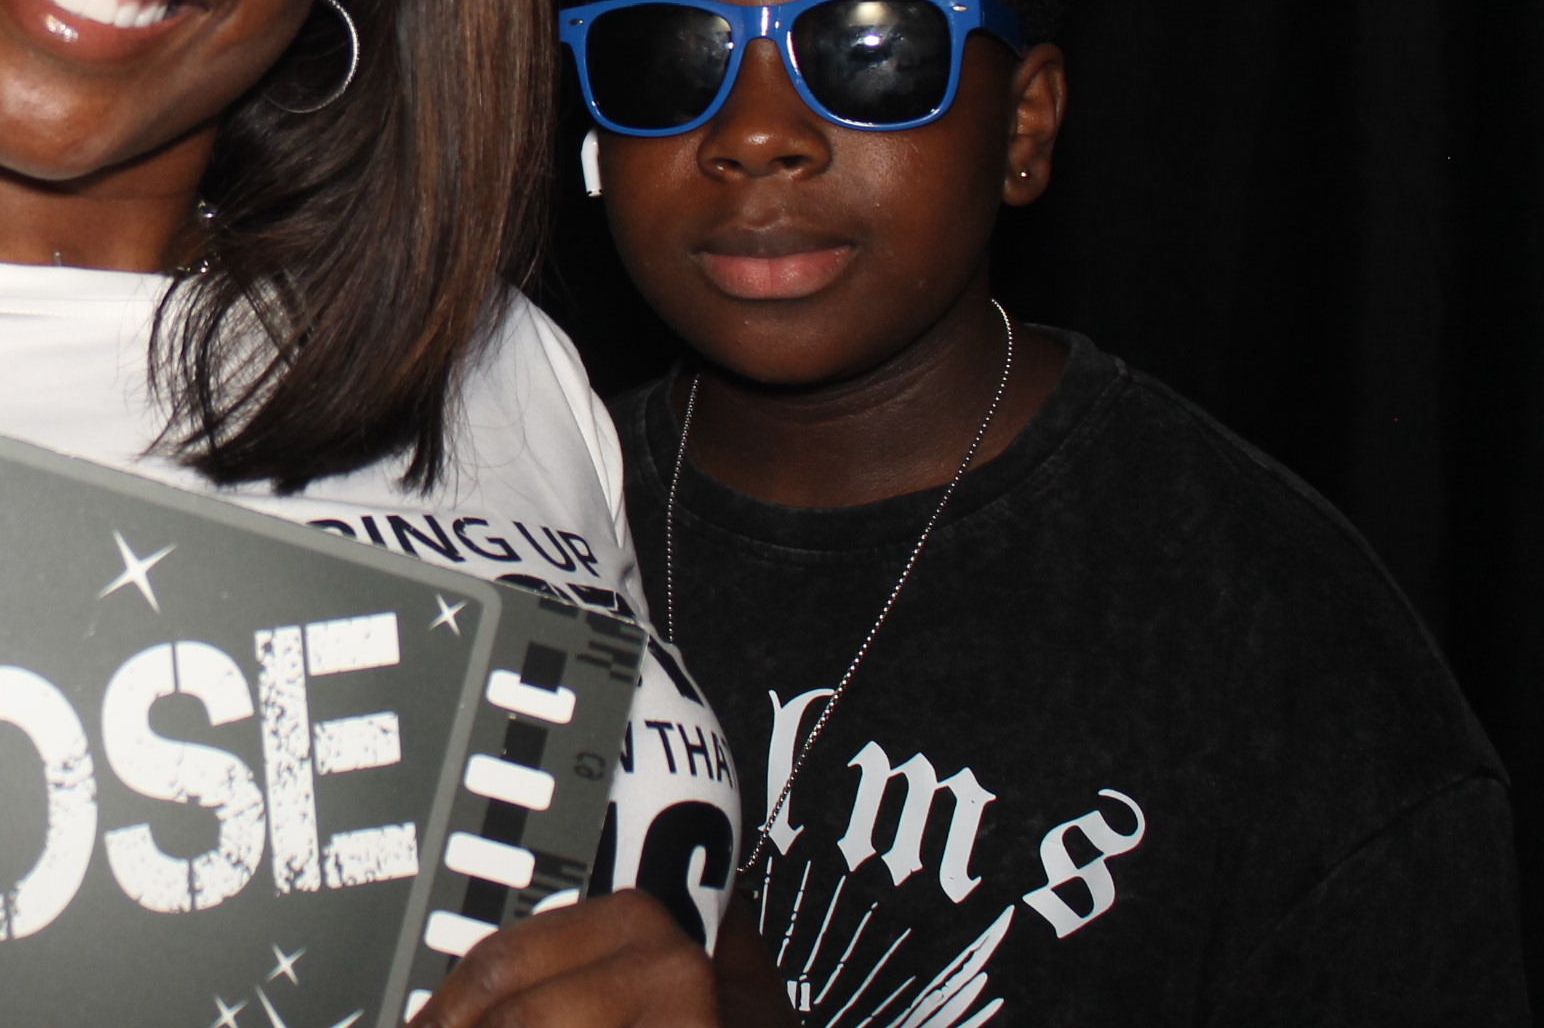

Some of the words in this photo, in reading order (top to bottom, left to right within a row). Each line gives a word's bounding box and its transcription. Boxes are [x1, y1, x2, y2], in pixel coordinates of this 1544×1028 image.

[512, 521, 601, 578] UP
[644, 719, 737, 789] THA
[758, 688, 1145, 939] lms
